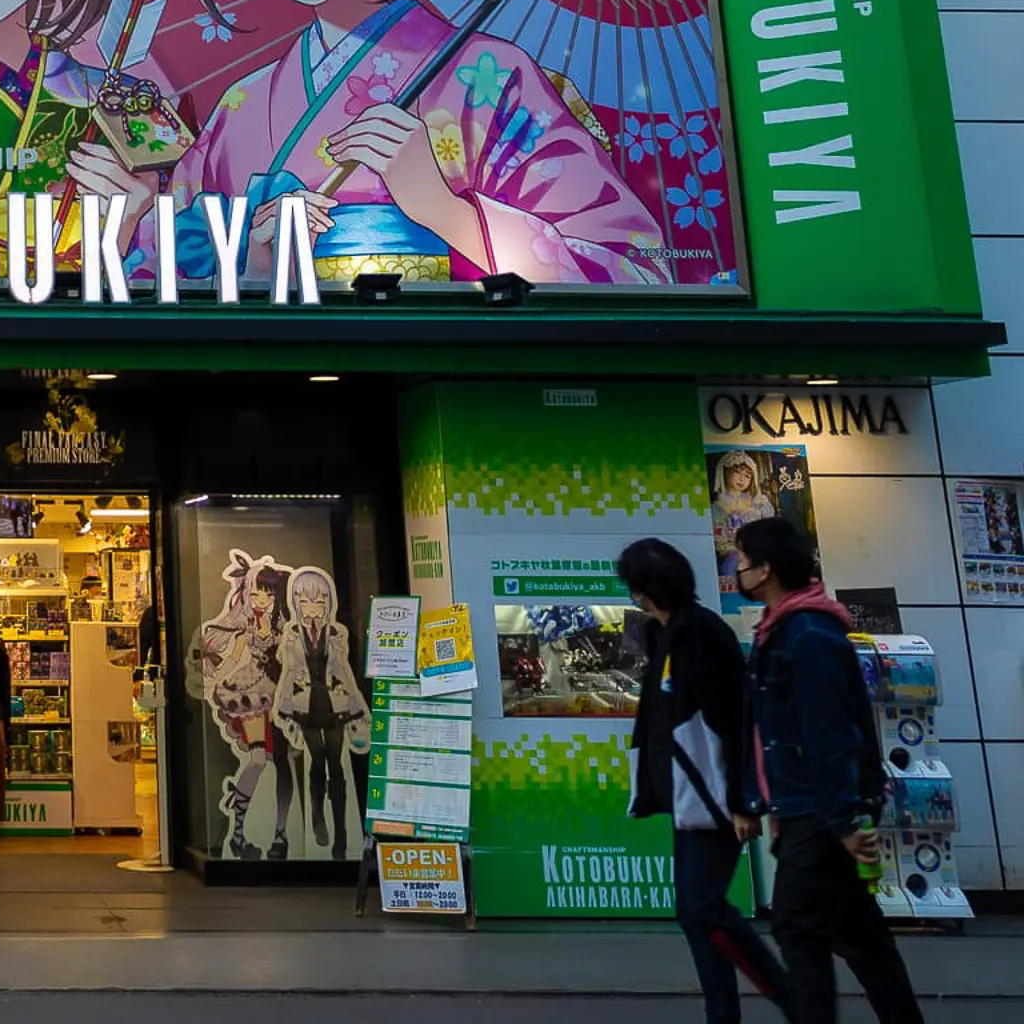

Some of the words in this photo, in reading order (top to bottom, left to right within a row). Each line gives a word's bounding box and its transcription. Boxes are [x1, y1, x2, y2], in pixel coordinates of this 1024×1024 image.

[639, 249, 714, 260] KOTOBUKIYA
[707, 393, 909, 439] OKAJIMA
[20, 430, 55, 449] FINAL
[58, 430, 109, 449] FANTASY
[26, 447, 70, 465] PREMIUM
[71, 447, 103, 465] STORE
[375, 630, 410, 639] クーポン
[561, 846, 627, 854] CRAFTSMANSHIP
